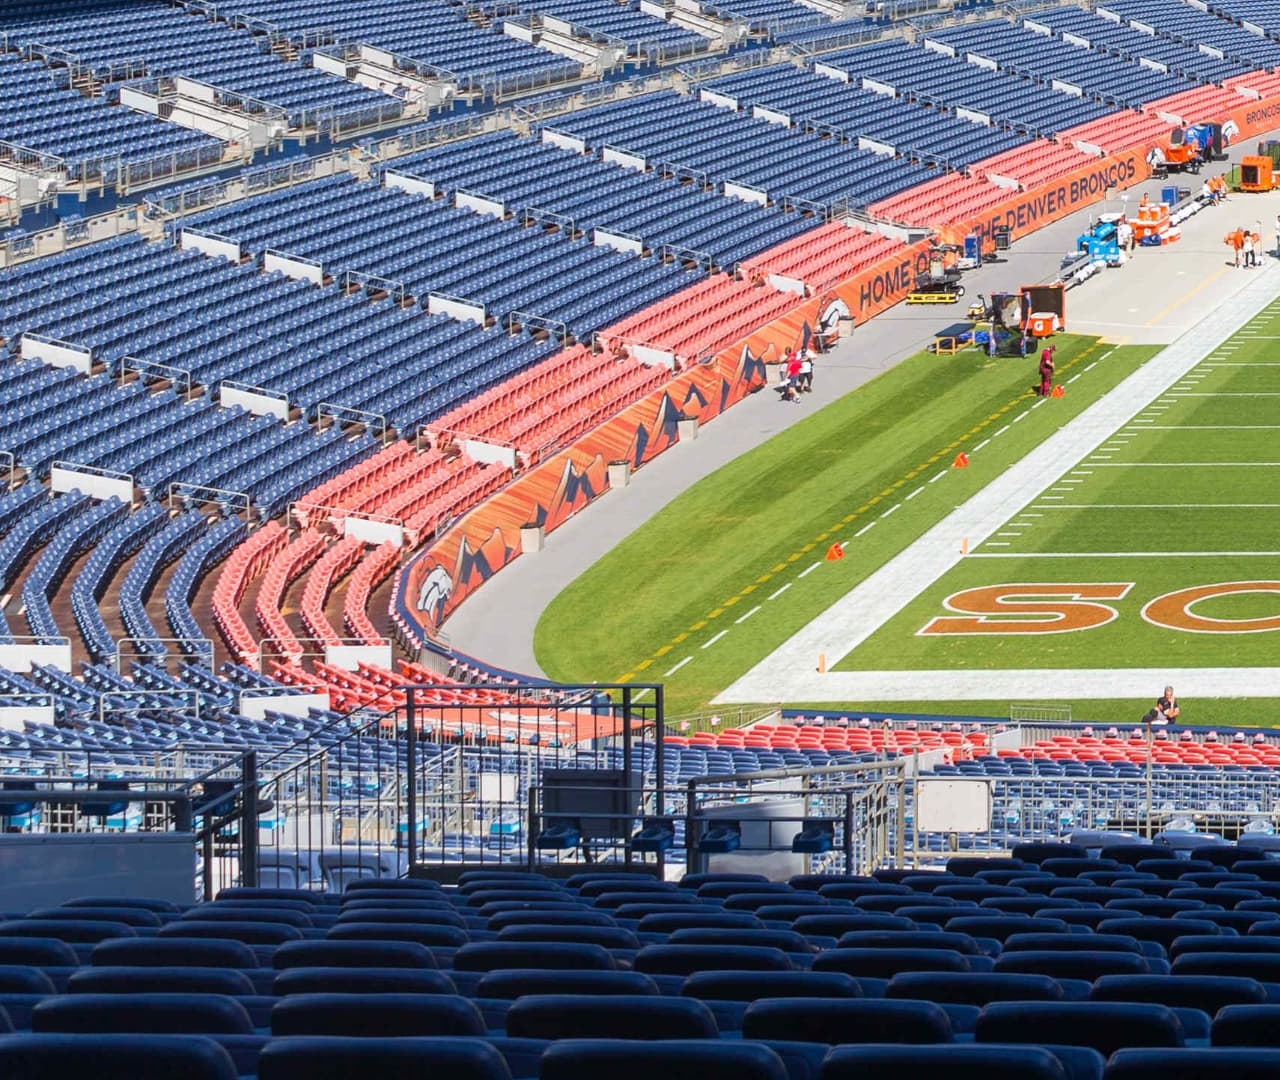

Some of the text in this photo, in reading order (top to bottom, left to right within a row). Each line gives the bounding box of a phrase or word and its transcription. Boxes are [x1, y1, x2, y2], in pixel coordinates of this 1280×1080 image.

[859, 258, 912, 310] HOME
[1006, 188, 1067, 233] DENVER
[1068, 157, 1137, 207] BRONCOS
[1034, 321, 1044, 332] G
